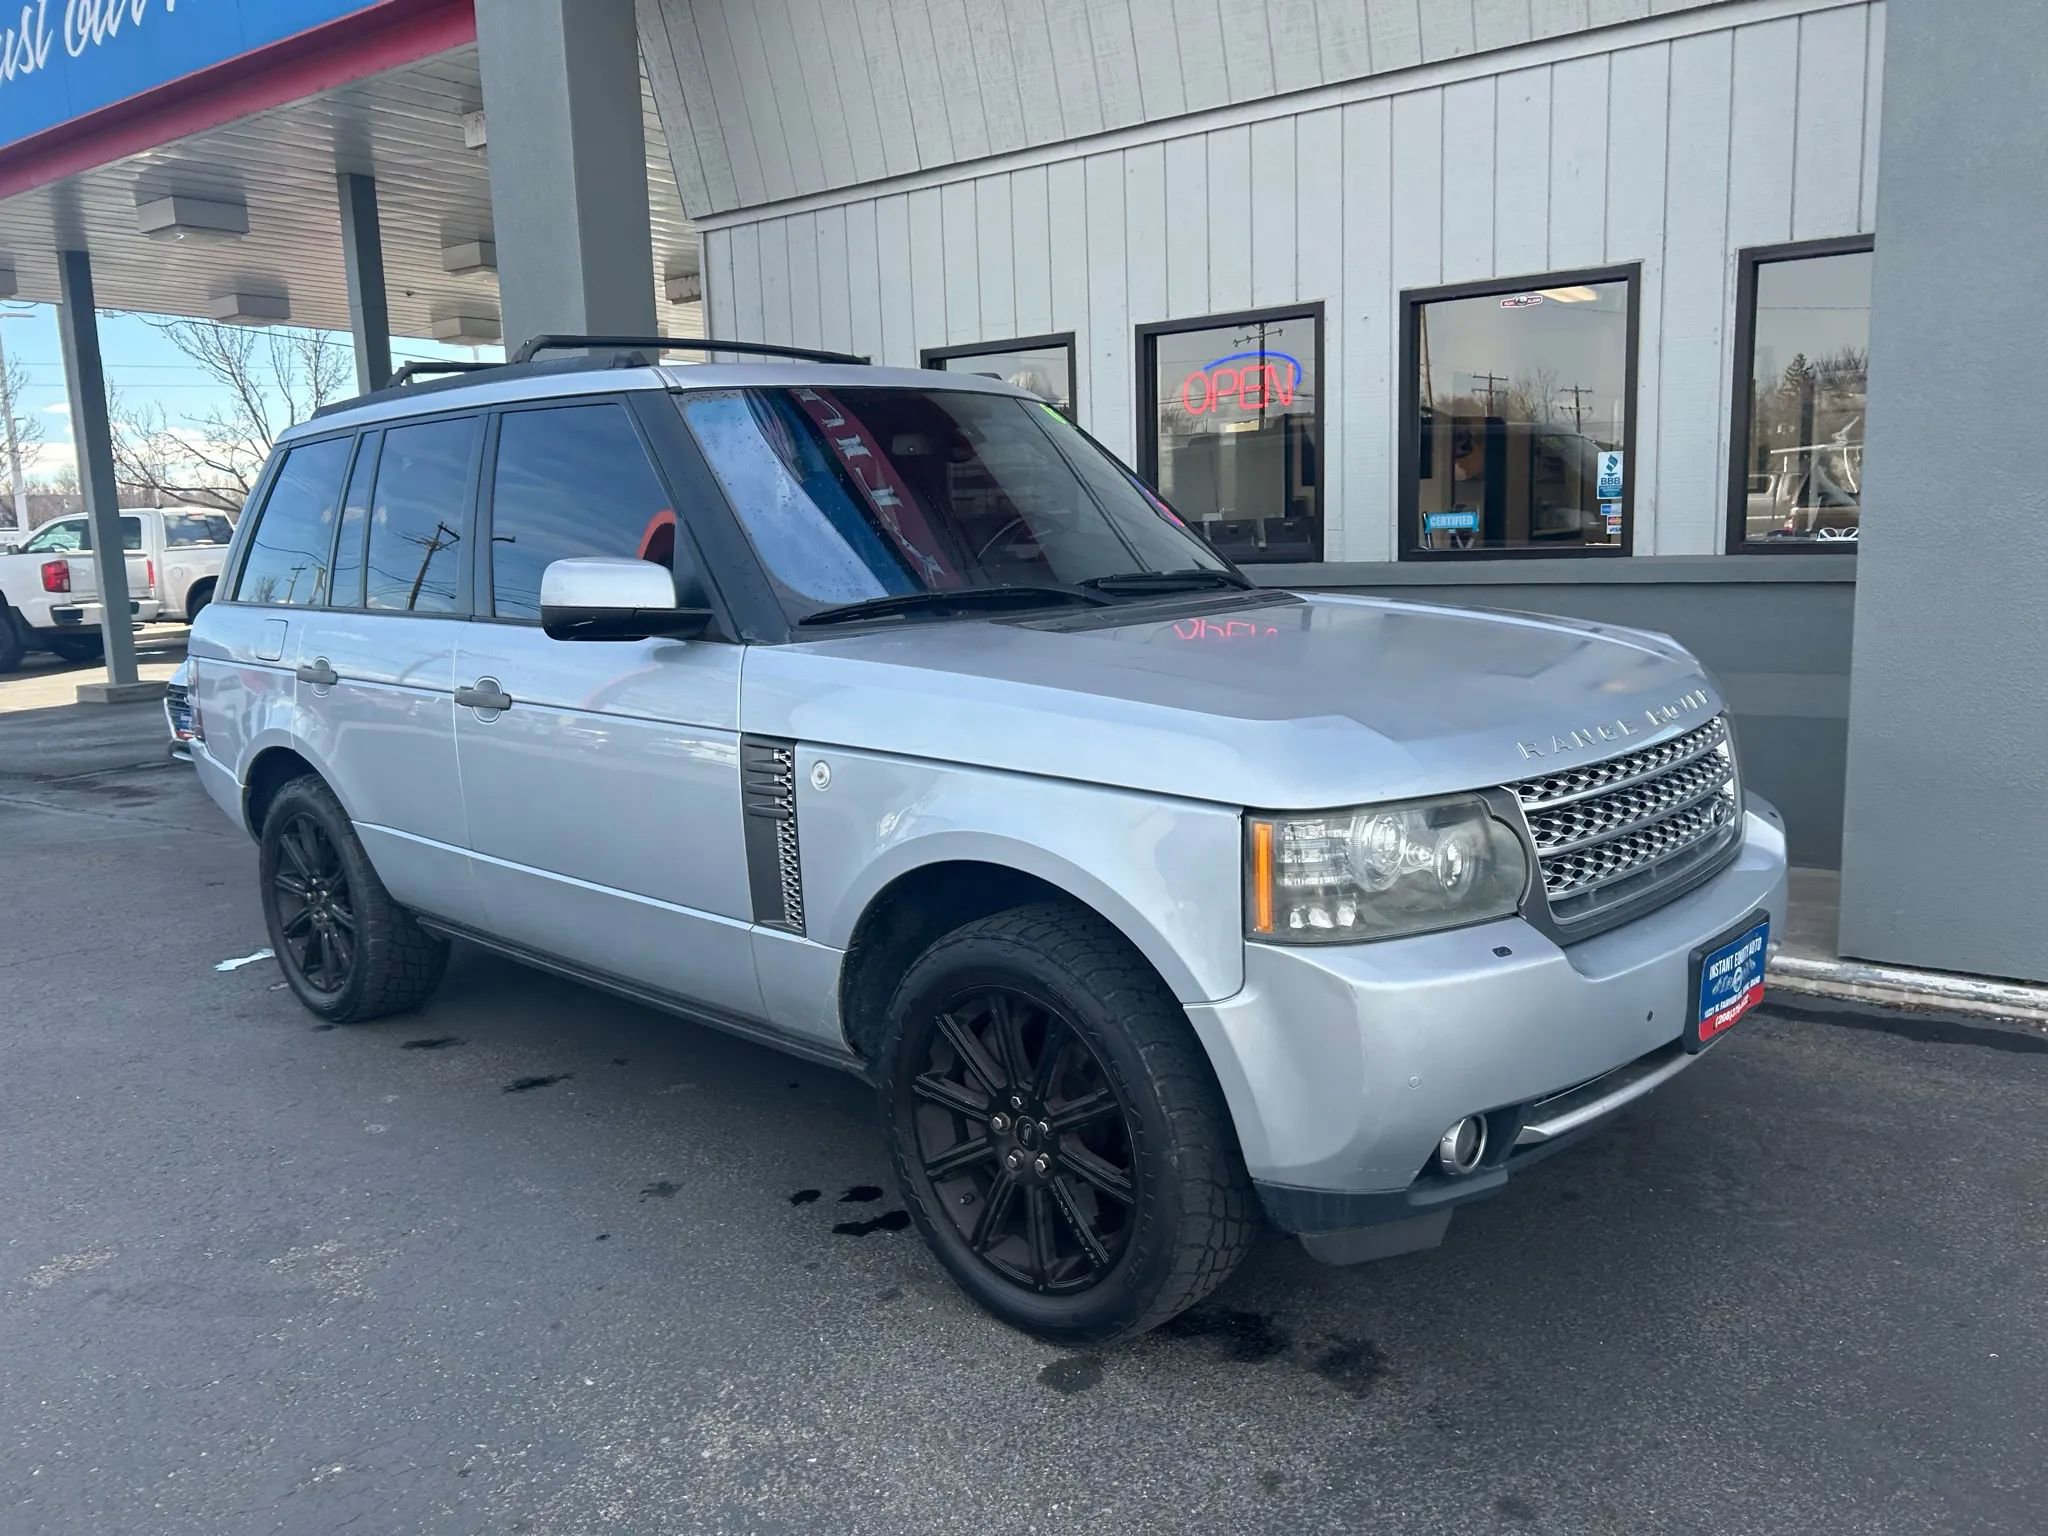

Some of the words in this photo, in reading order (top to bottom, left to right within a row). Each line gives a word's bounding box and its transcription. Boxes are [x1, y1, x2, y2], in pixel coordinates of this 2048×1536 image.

[1183, 363, 1294, 415] OPEN
[1600, 477, 1621, 485] BBB
[1430, 515, 1473, 527] CERTIFIED
[1516, 720, 1638, 760] RANGE
